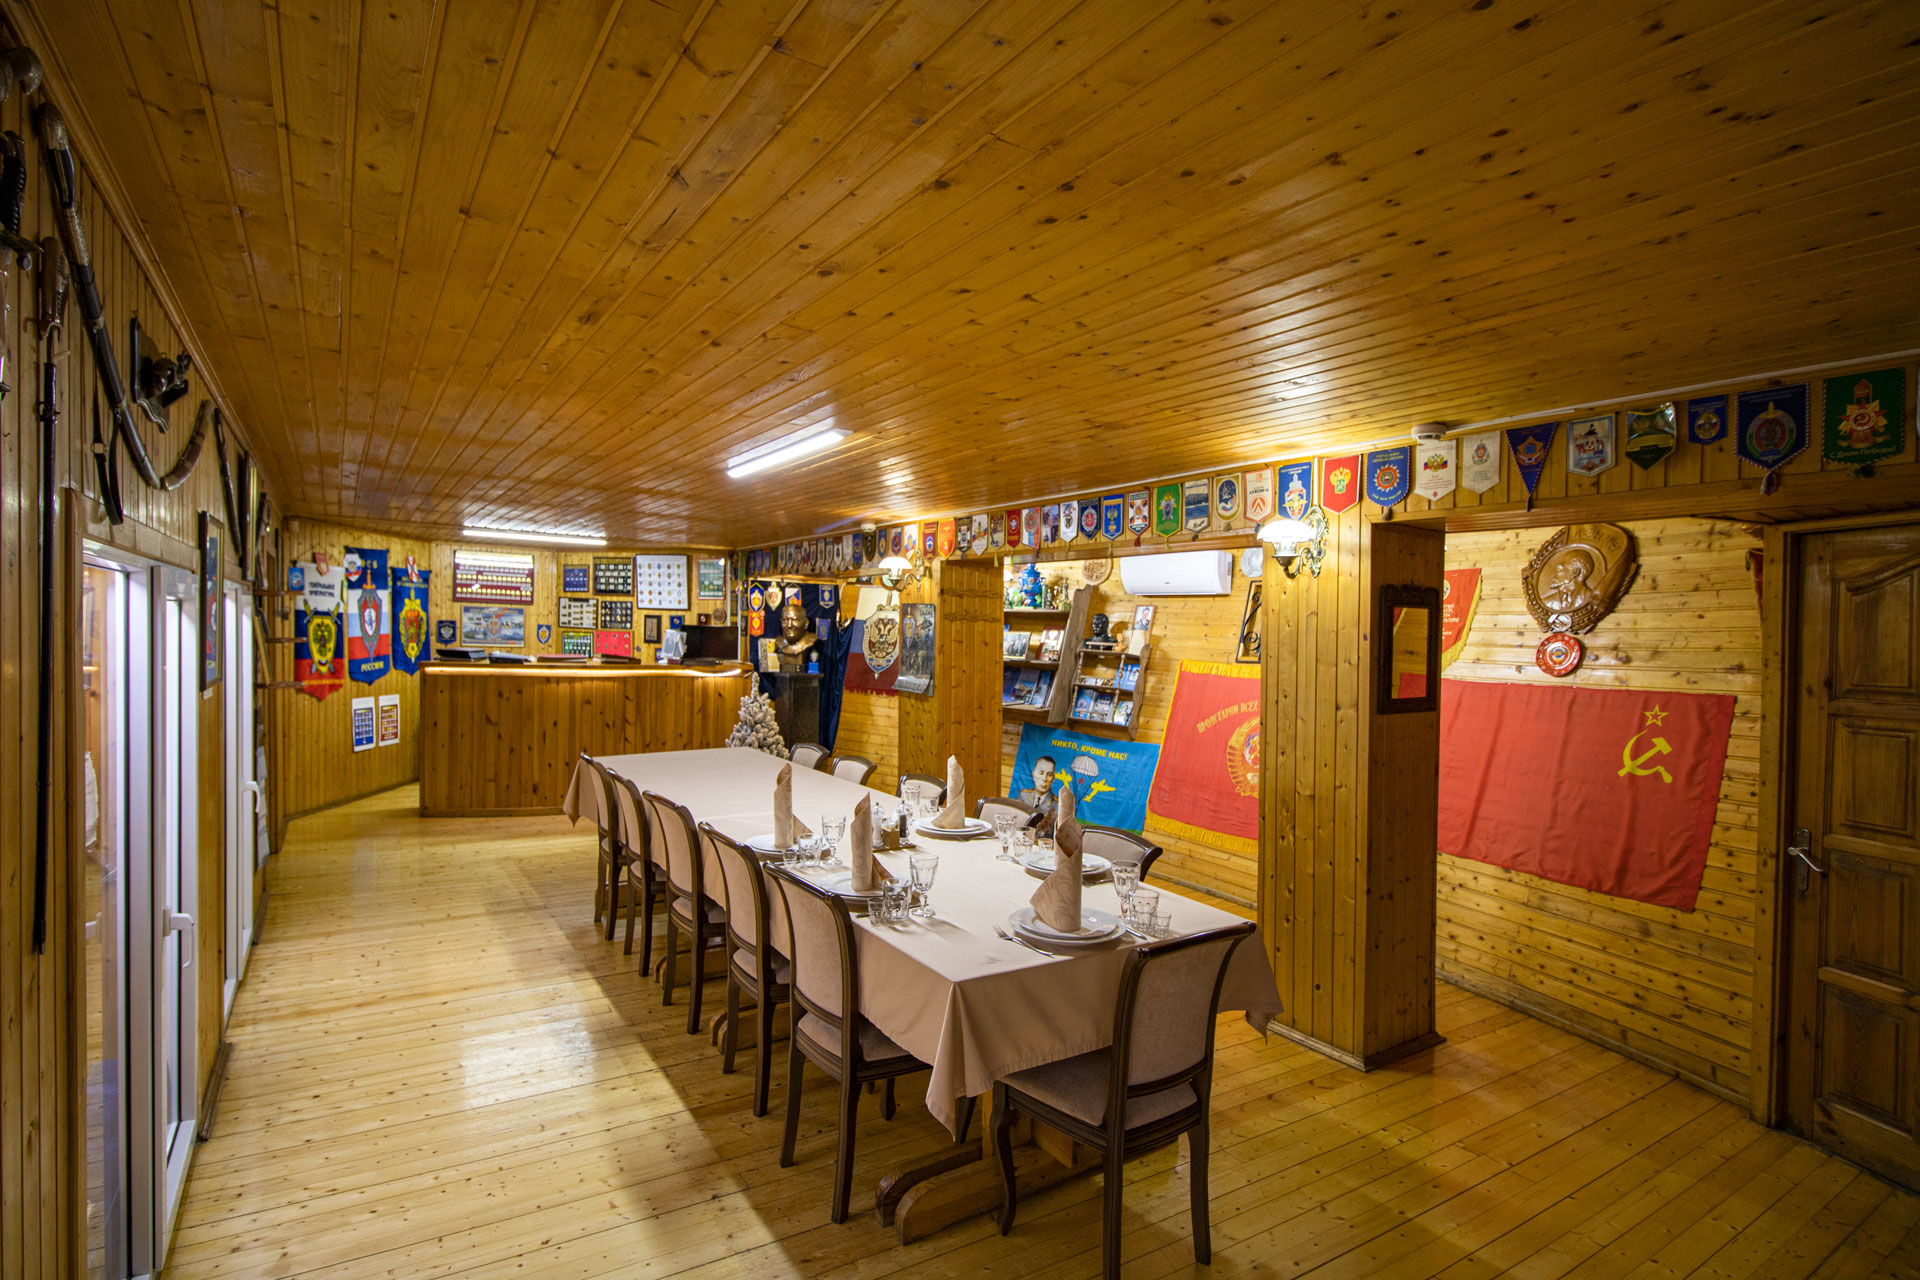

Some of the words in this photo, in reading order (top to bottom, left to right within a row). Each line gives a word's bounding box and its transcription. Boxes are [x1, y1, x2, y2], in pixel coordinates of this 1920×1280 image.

[1197, 704, 1239, 734] ПРОЛЕТАРИИ
[1240, 700, 1258, 713] ВСЕХ
[1051, 739, 1079, 752] НИКТО,
[1081, 744, 1107, 757] КРОМЕ
[1108, 751, 1128, 761] НАС!
